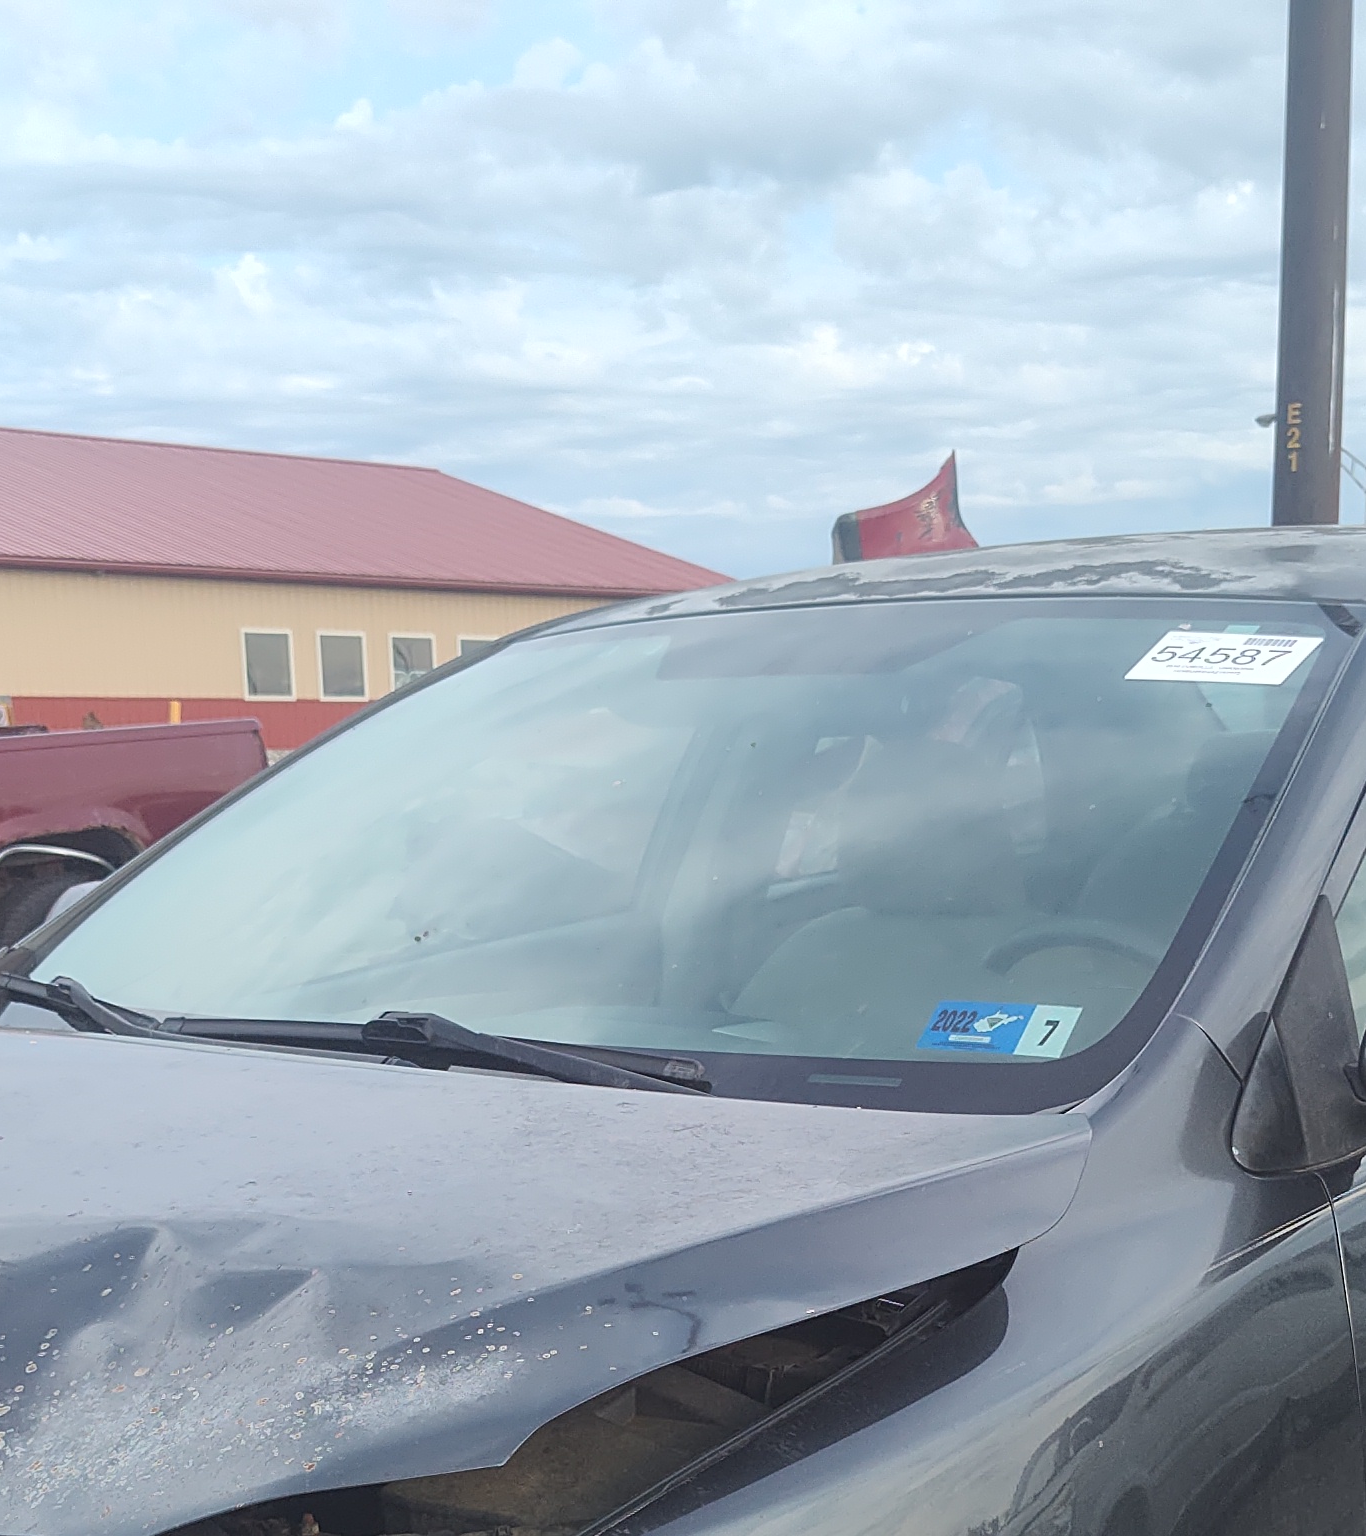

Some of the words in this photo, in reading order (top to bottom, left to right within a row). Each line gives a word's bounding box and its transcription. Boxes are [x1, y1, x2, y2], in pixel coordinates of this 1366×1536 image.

[1151, 646, 1293, 667] 54587
[931, 1009, 978, 1033] 2022
[1037, 1020, 1060, 1046] 7
